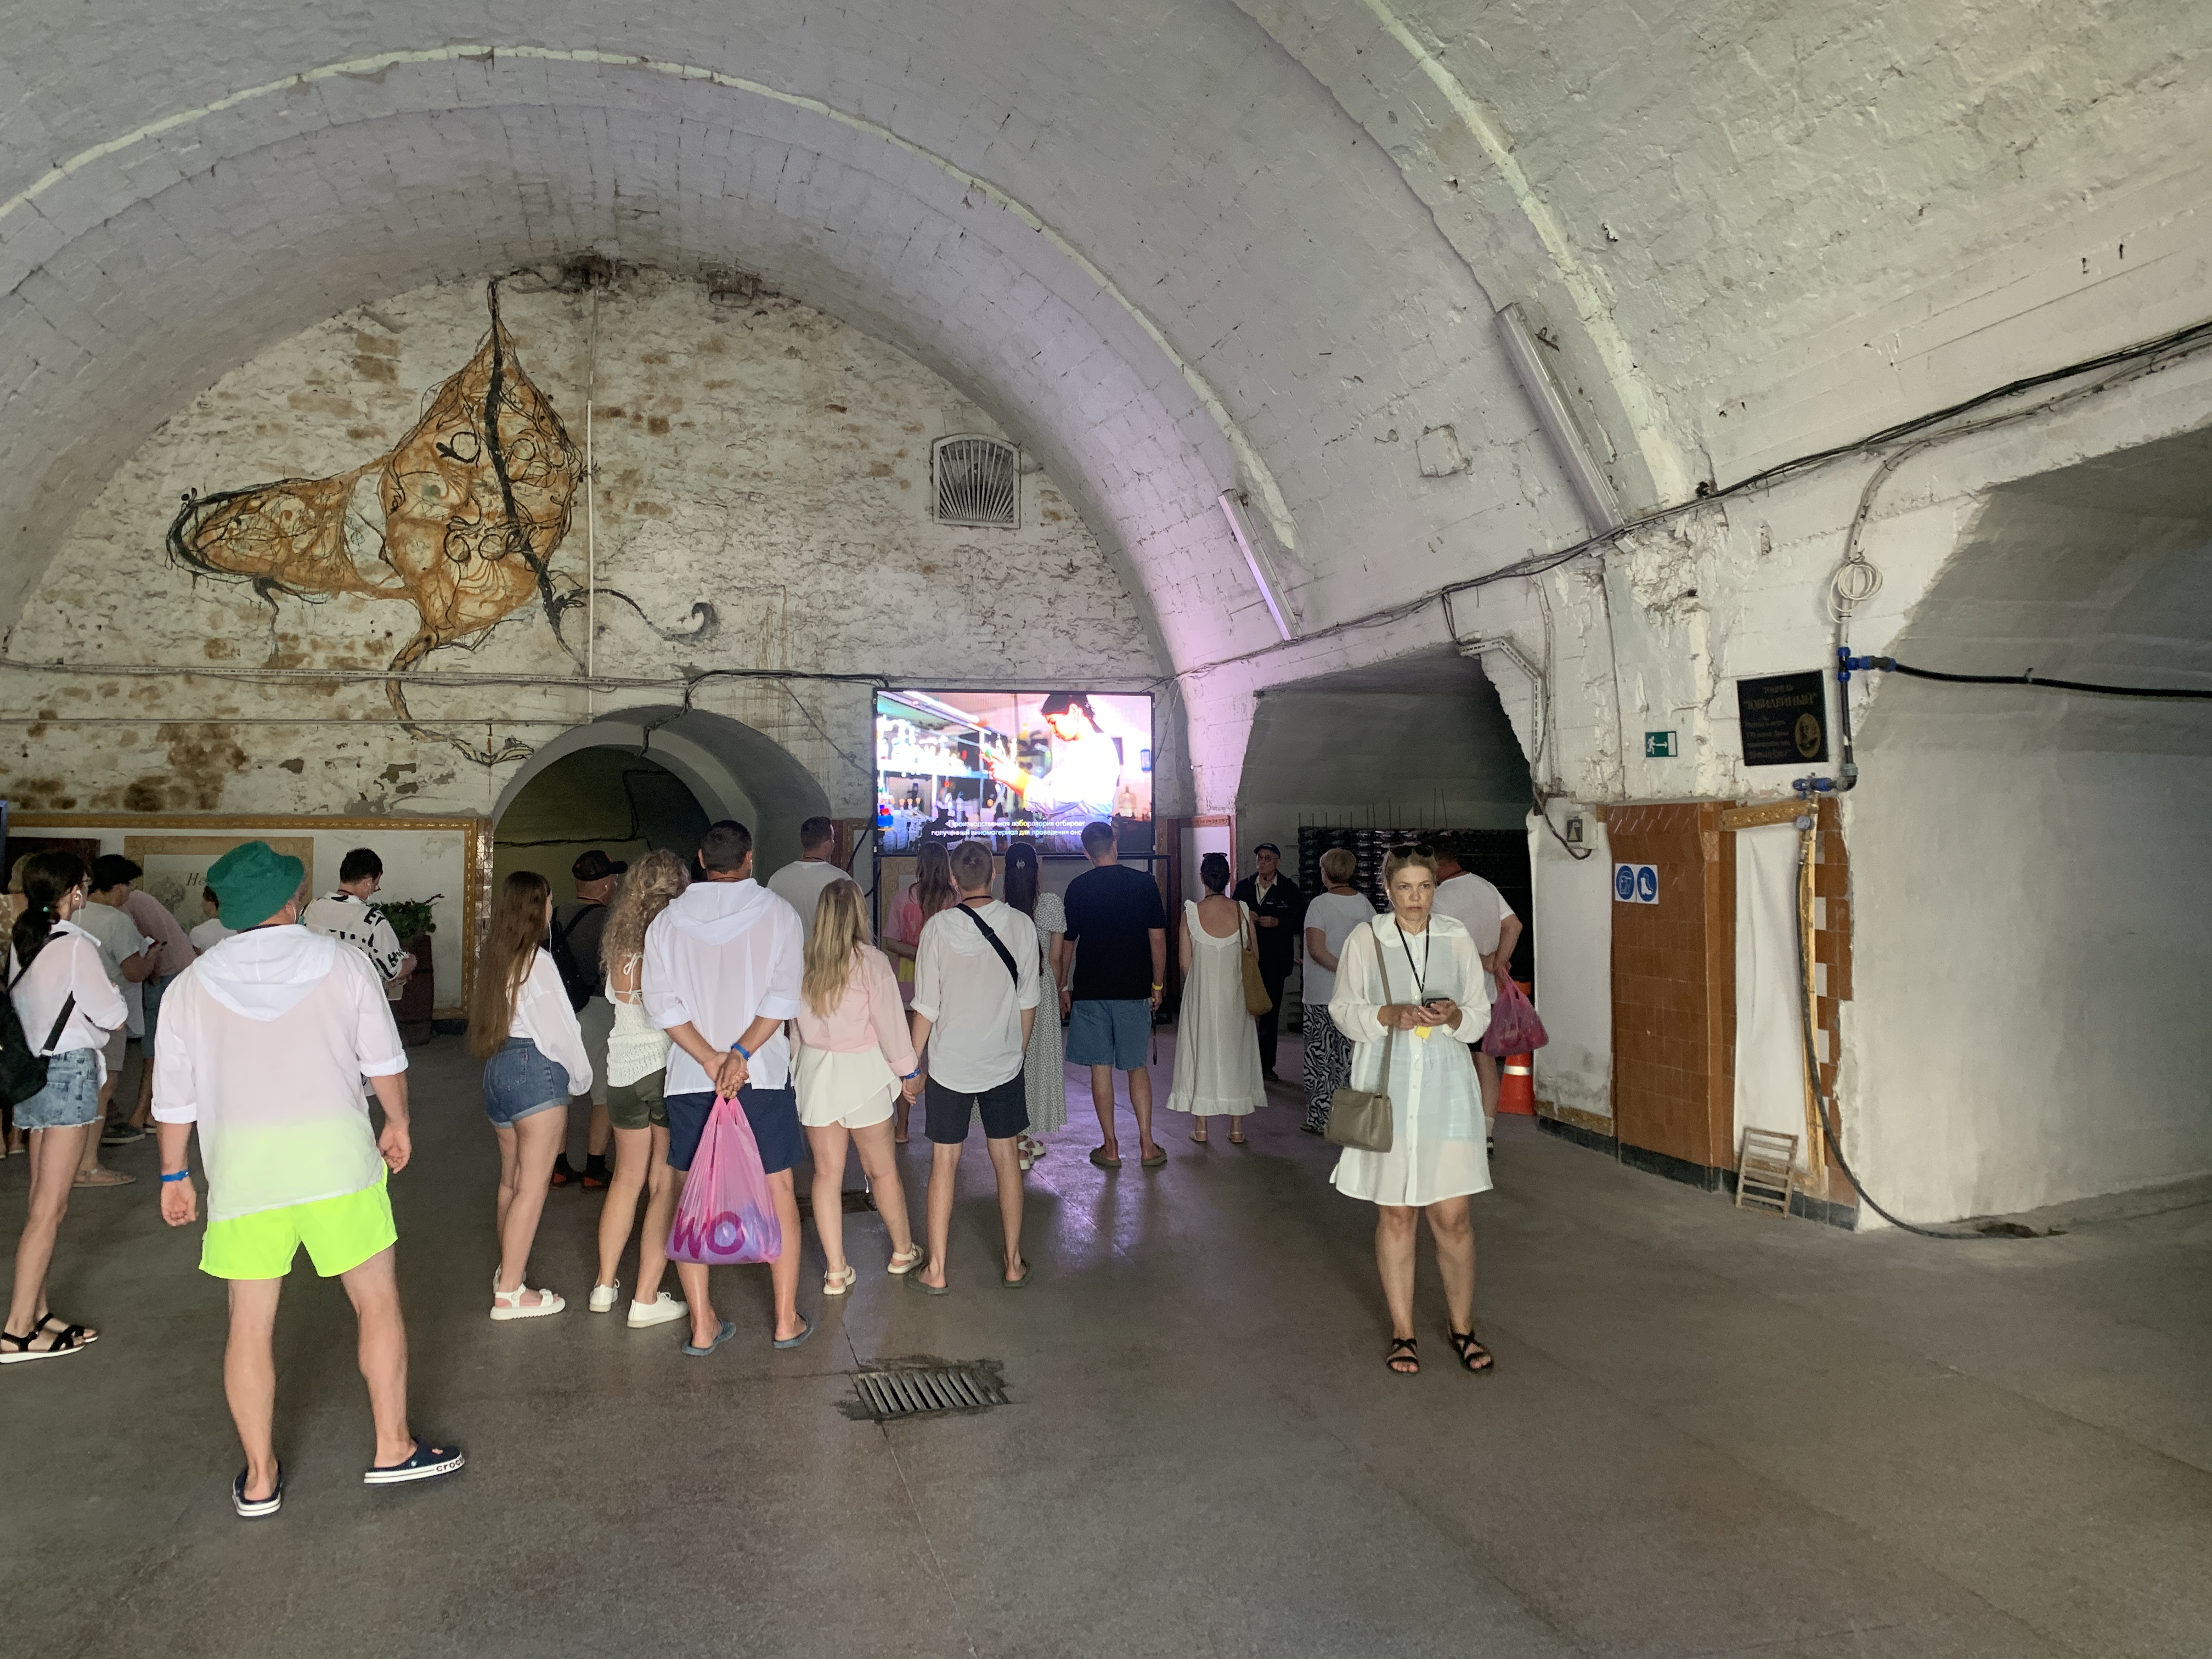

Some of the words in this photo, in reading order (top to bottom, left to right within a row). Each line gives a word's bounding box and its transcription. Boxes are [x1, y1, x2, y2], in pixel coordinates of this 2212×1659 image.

[949, 819, 1010, 828] Производственная
[1011, 819, 1054, 828] лаборатория
[1055, 819, 1086, 828] отбирает
[931, 829, 970, 838] полученный
